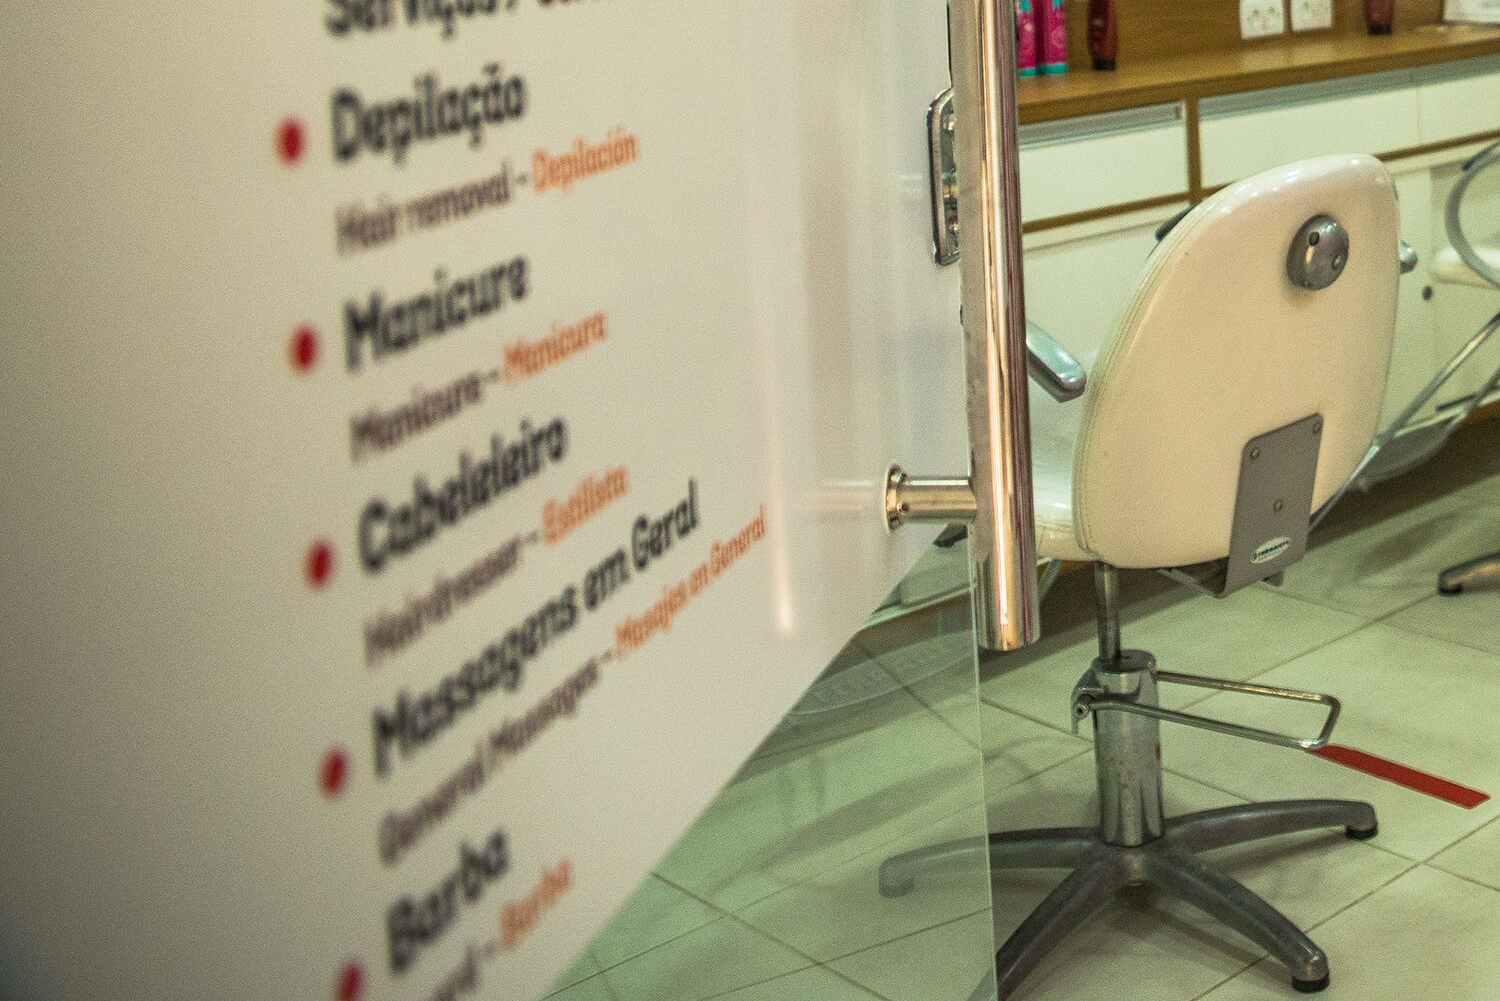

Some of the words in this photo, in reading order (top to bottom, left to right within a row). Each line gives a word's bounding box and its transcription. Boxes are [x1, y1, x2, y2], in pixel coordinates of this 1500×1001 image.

[330, 61, 528, 168] Depilação
[343, 253, 530, 372] Manicure
[582, 545, 632, 611] em
[631, 478, 698, 573] Geral
[386, 827, 510, 974] Barba
